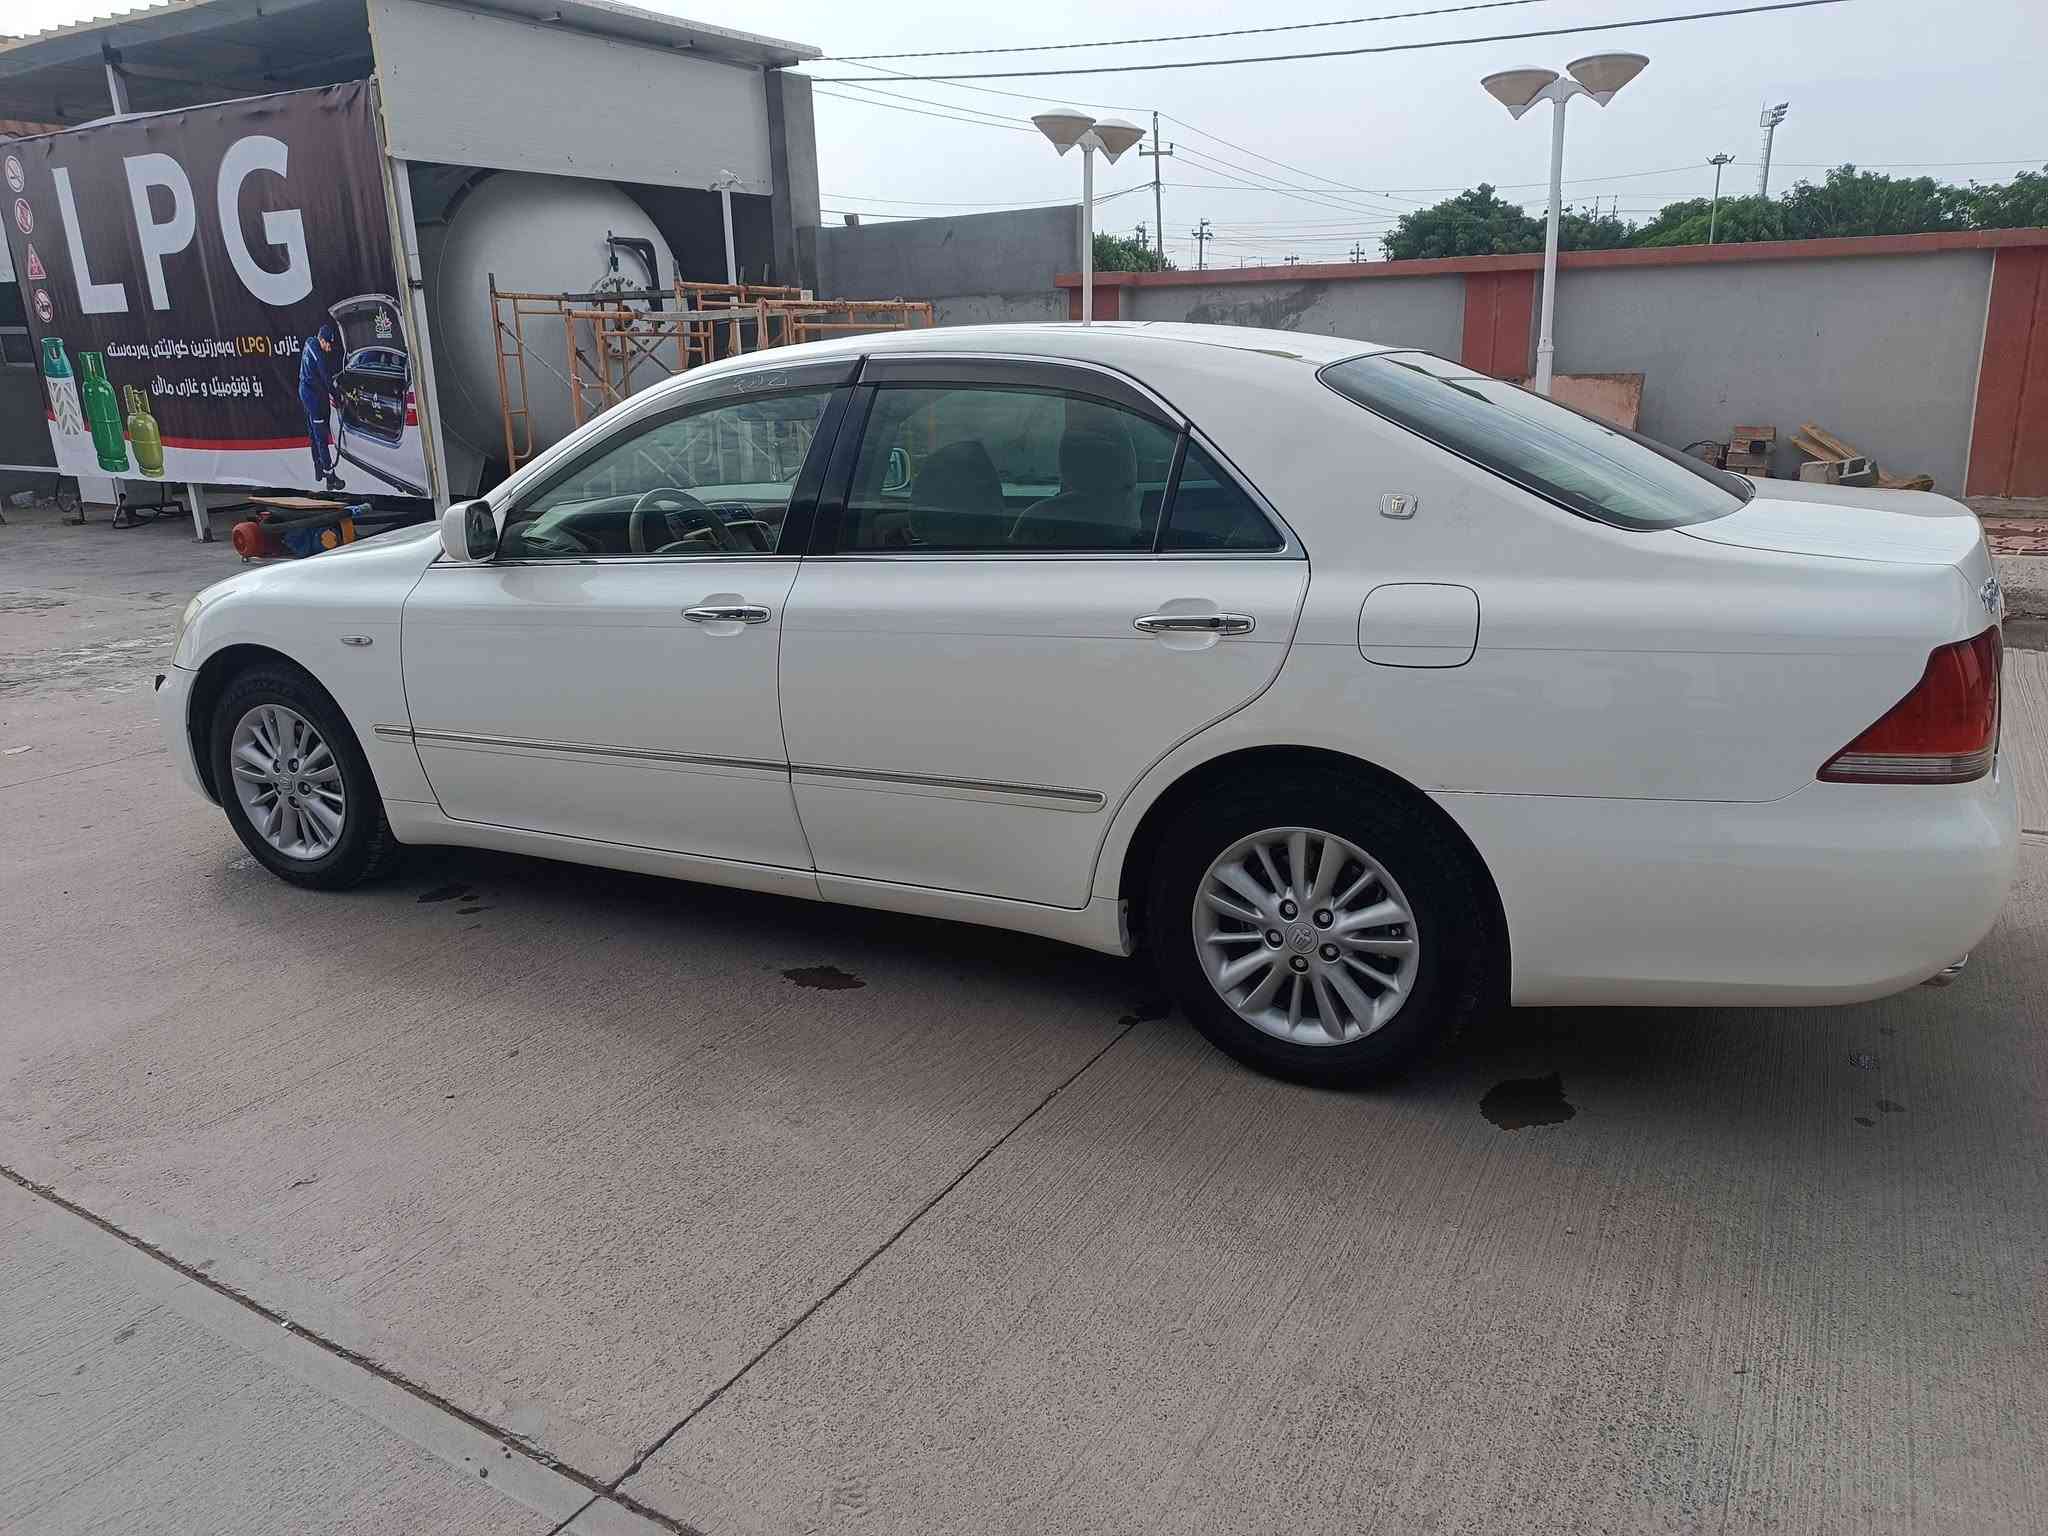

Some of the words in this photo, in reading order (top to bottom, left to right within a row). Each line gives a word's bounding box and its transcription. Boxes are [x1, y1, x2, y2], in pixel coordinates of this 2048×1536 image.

[51, 135, 313, 315] LPG
[201, 382, 208, 397] و
[252, 375, 264, 397] بۆ
